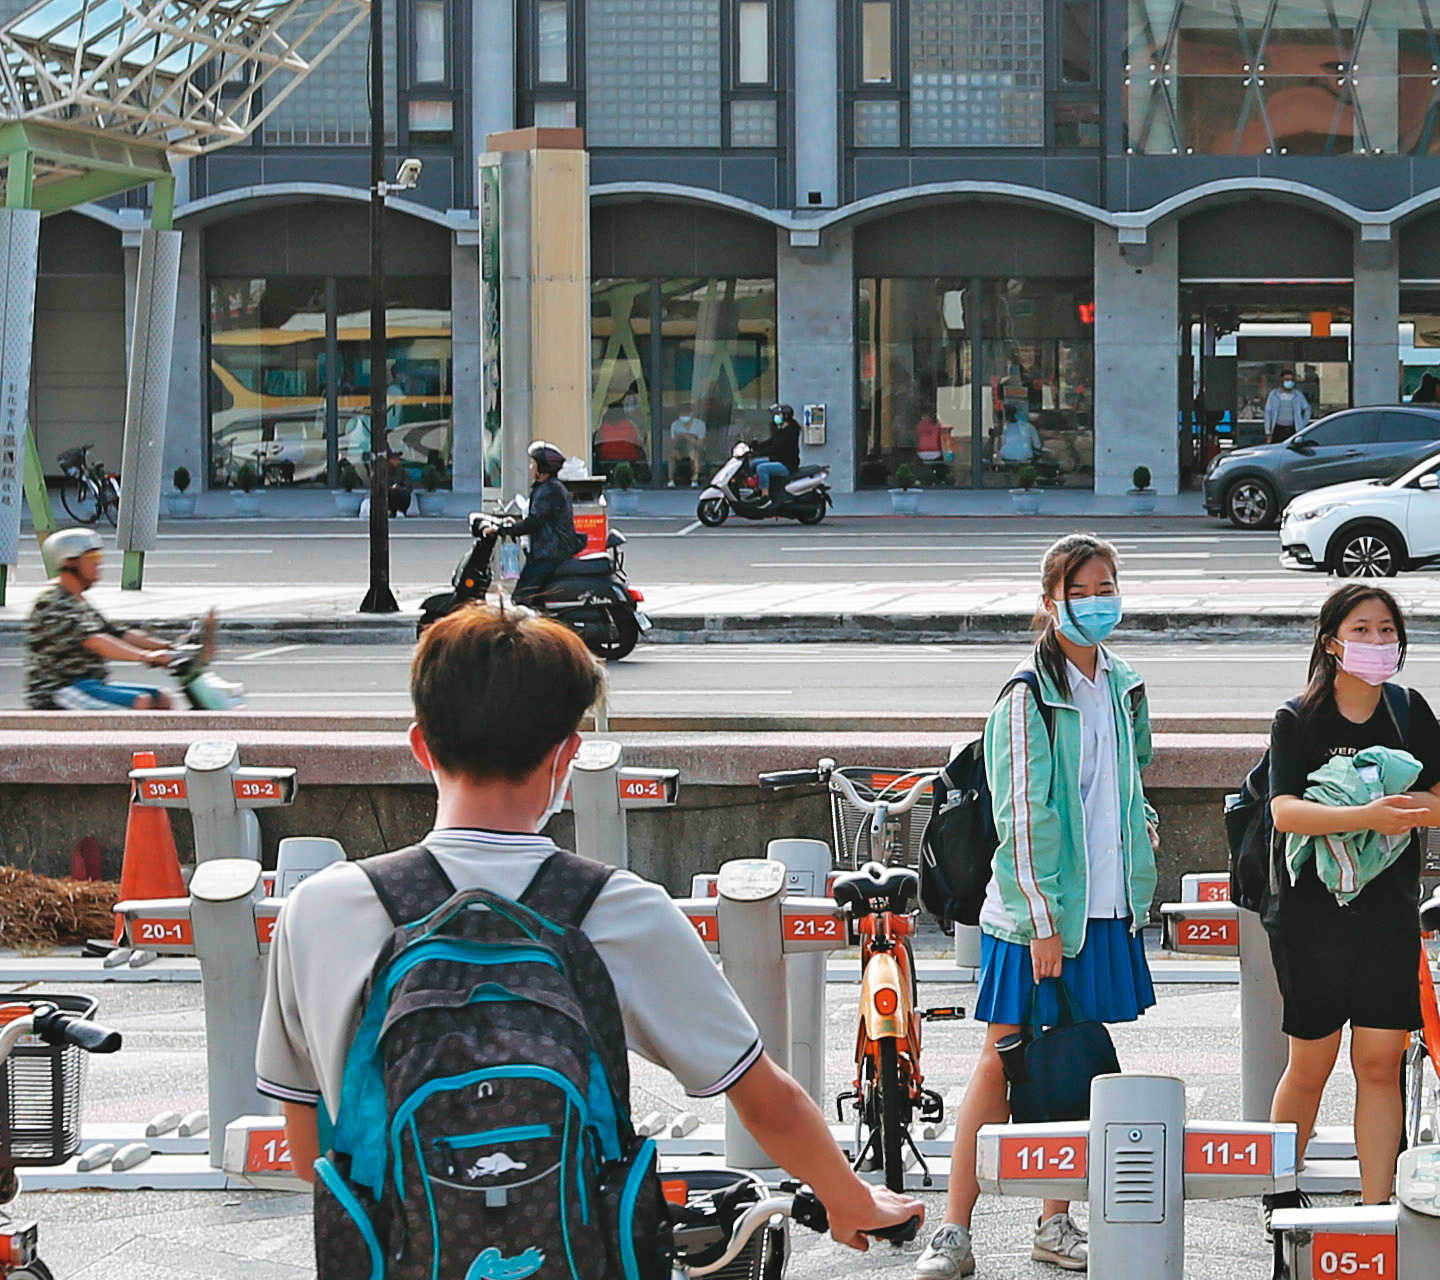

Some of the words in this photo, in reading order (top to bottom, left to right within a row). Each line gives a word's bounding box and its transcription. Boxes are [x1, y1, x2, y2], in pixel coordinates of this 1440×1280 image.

[150, 784, 178, 795] 39-1
[243, 784, 273, 795] 39-2
[627, 783, 657, 794] 40-2
[142, 924, 181, 938] 20-1
[794, 921, 835, 934] 21-2
[1188, 925, 1226, 939] 22-1
[263, 1140, 292, 1162] 12
[1017, 1147, 1074, 1169] 11-2
[1202, 1142, 1256, 1165] 11-1
[1321, 1252, 1383, 1274] 05-1
